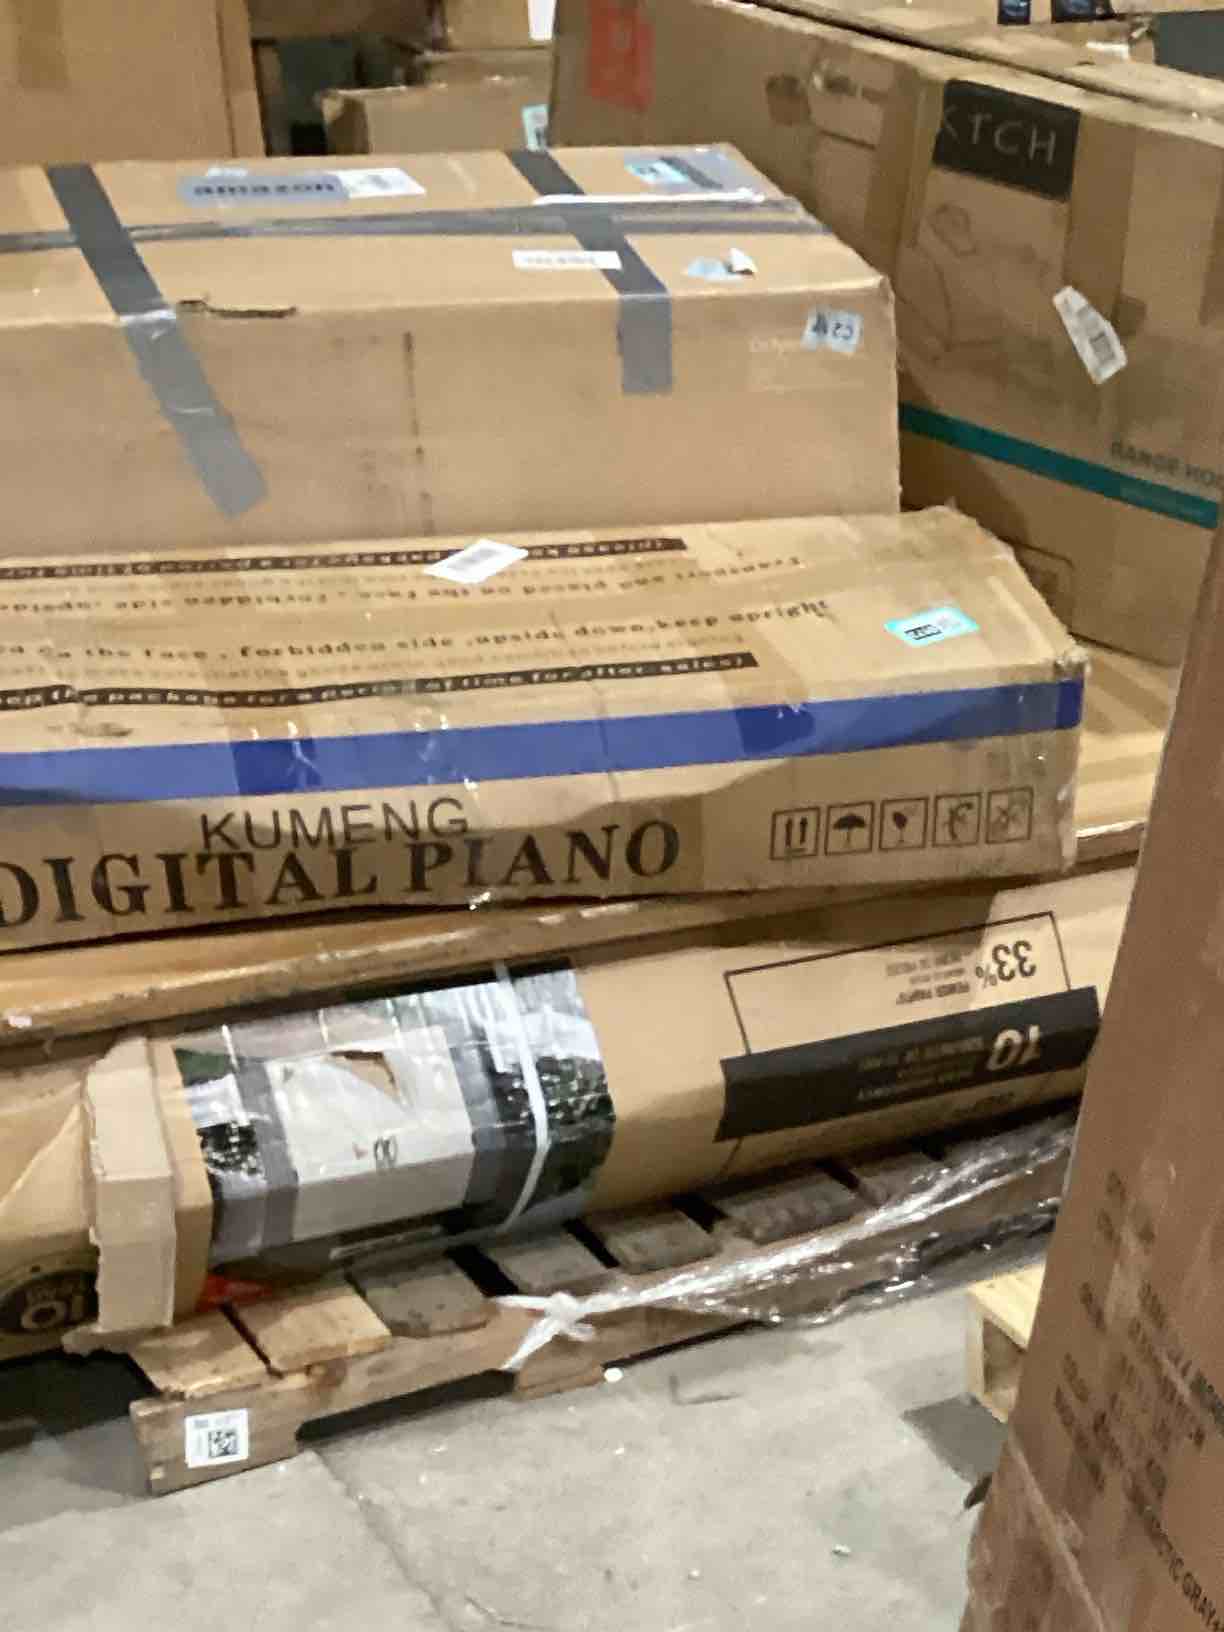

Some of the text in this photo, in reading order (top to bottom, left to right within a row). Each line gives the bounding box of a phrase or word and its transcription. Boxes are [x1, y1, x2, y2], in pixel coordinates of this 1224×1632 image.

[200, 797, 469, 852] KUMENG
[0, 819, 679, 929] DIGITAL PIANO
